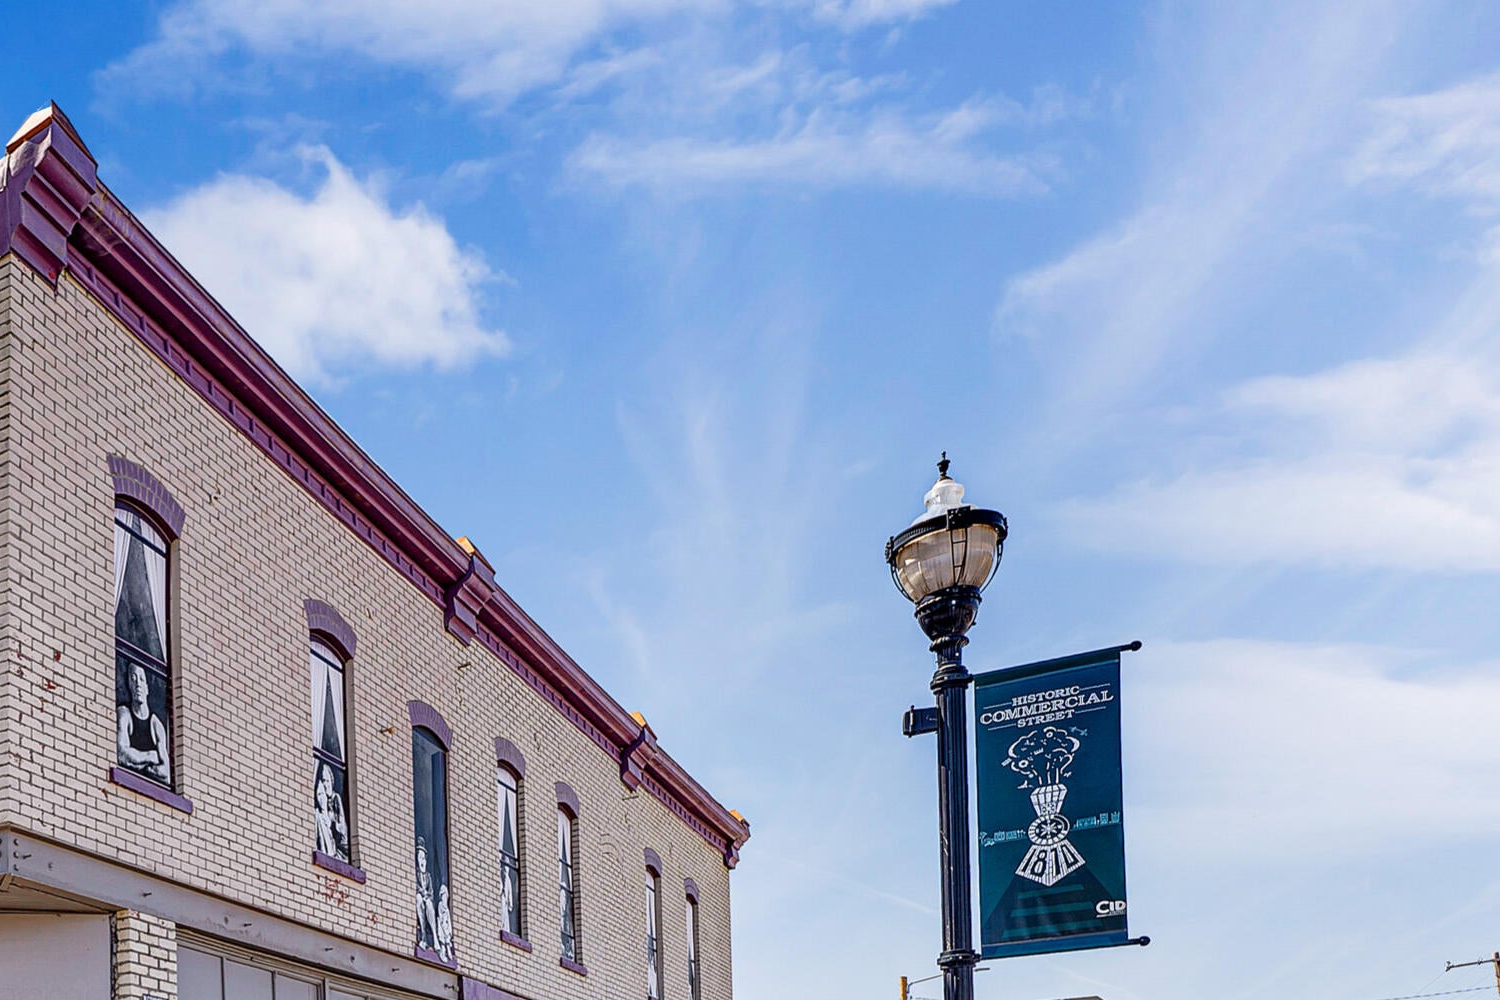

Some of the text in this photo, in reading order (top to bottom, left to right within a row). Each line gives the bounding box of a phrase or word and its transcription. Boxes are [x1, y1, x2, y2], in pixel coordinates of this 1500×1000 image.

[1012, 686, 1080, 707] HISTORIC
[980, 690, 1114, 725] COMMERCIAL
[1017, 709, 1075, 728] STREET
[1021, 845, 1080, 877] 1870
[1095, 901, 1126, 914] CID
